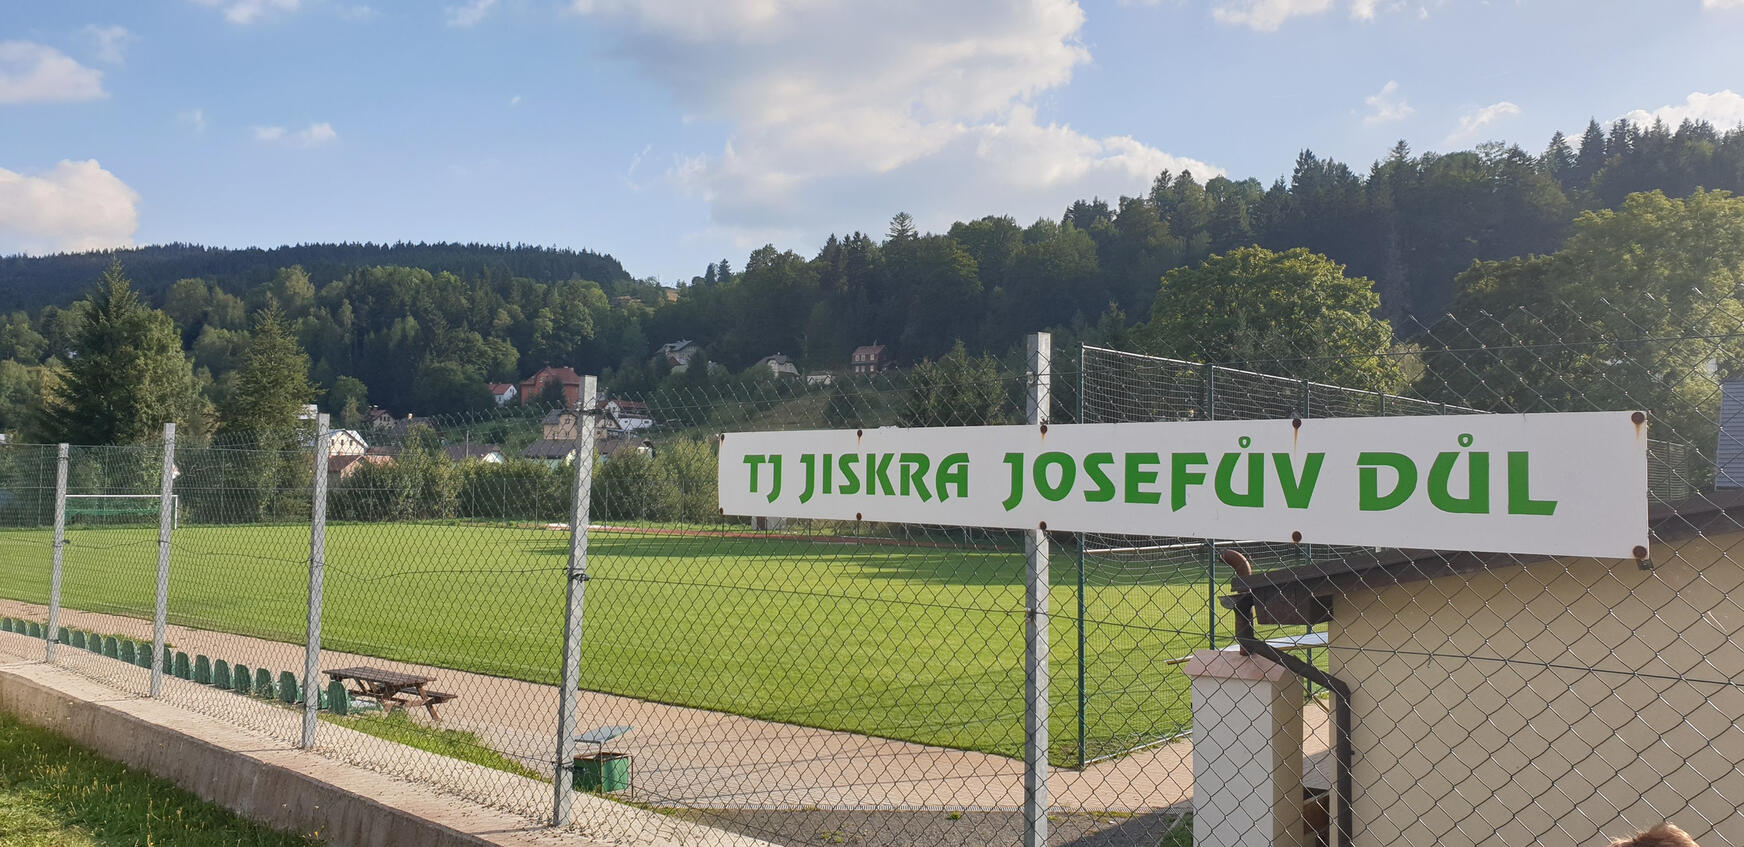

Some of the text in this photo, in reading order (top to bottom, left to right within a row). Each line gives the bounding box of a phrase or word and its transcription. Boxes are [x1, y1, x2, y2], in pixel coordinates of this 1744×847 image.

[742, 431, 1558, 517] TJ JISKRA JOSEFŮV DŮL
